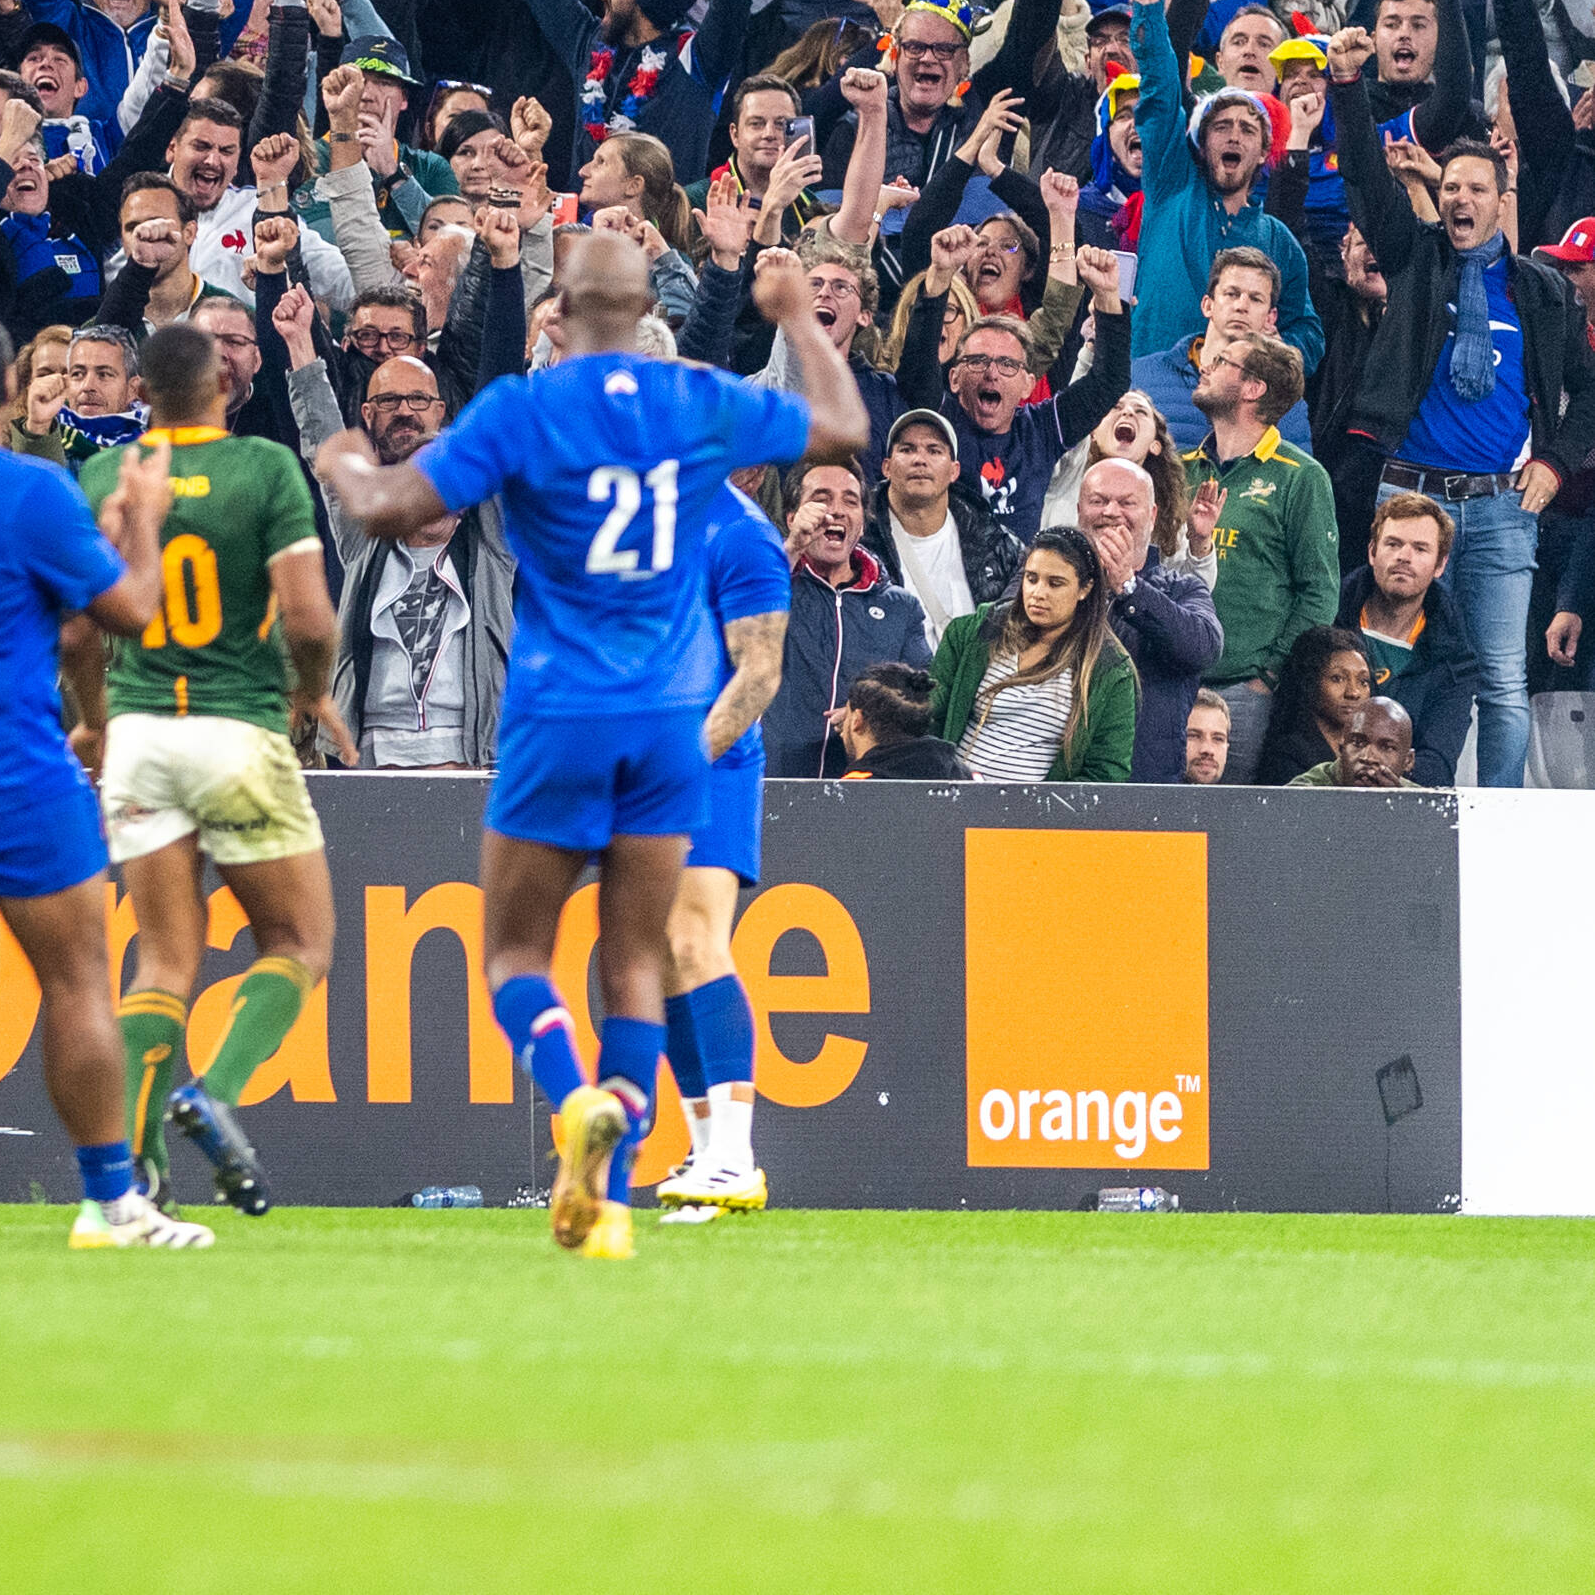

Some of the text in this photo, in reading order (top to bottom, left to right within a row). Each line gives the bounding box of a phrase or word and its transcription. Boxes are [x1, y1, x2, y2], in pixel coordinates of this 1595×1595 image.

[585, 459, 680, 574] 21
[141, 534, 223, 648] 0
[979, 1088, 1183, 1160] orange
